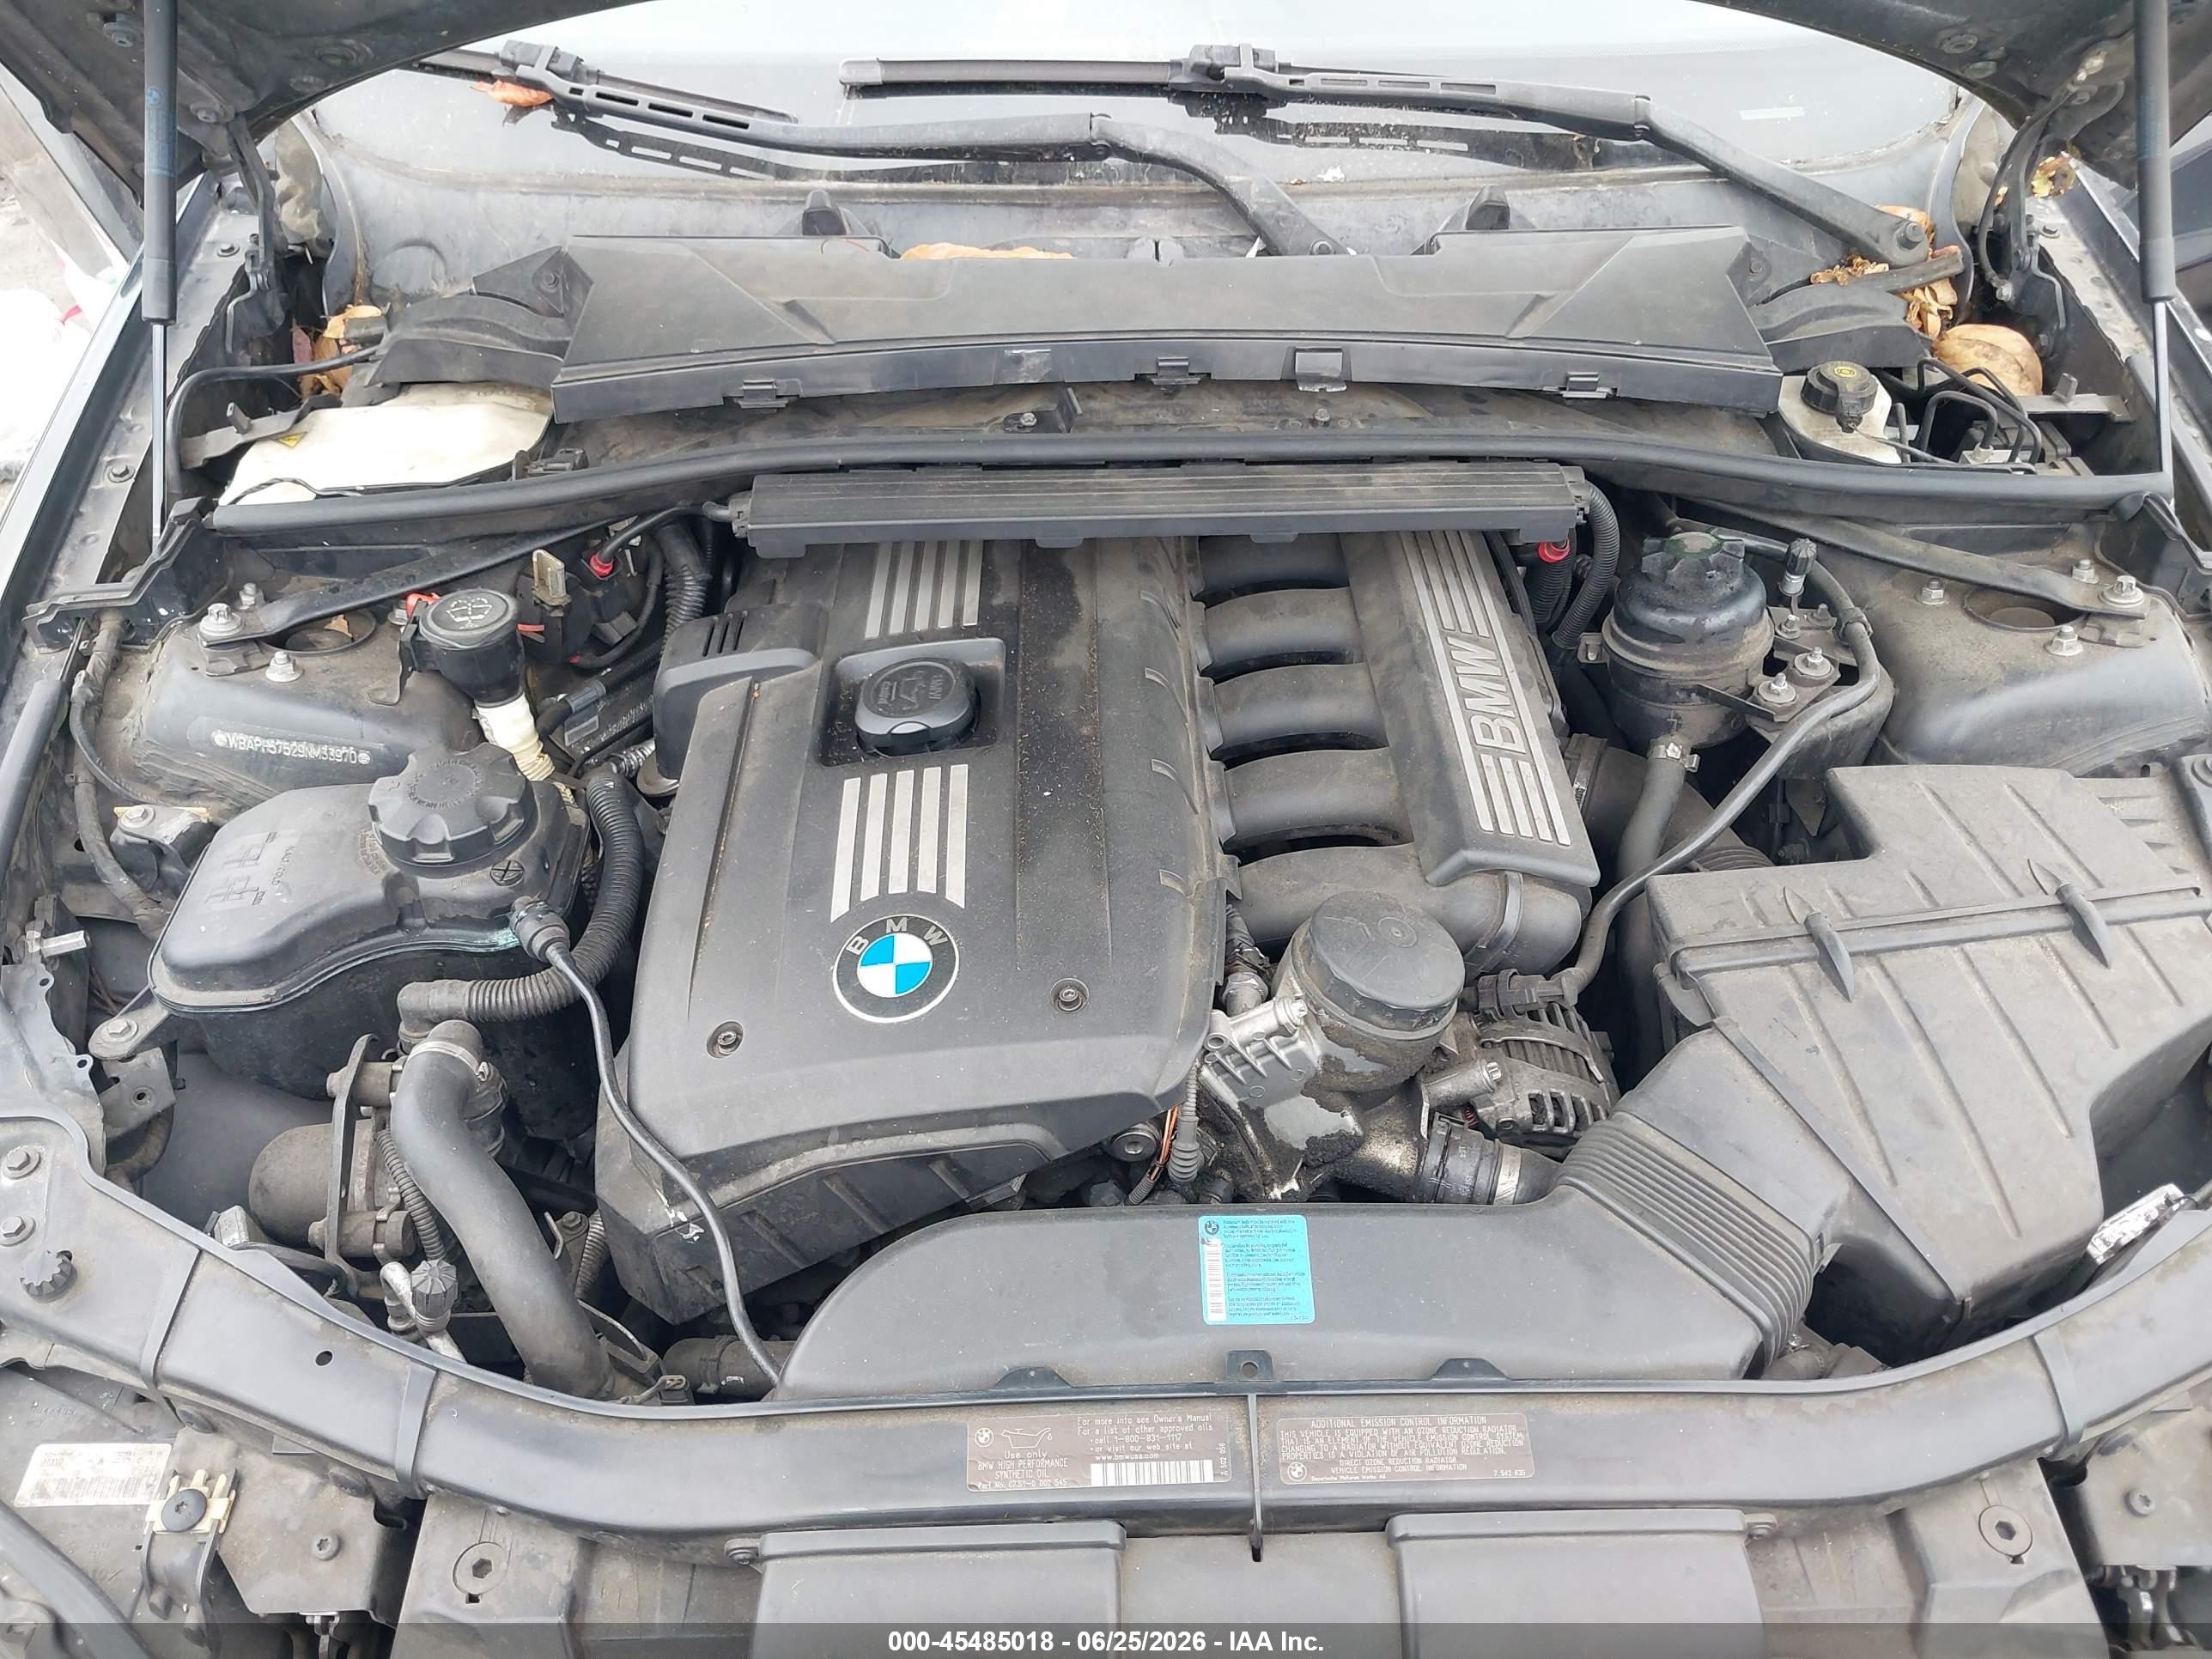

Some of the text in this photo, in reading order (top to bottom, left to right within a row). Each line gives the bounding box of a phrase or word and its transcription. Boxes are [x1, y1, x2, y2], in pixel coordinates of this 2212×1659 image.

[1447, 636, 1526, 754] BMW
[846, 917, 948, 955] BMW
[1079, 1417, 1090, 1425] For
[1187, 1413, 1212, 1422] Manual
[1311, 1415, 1486, 1429] ADDITIONAL EMISSION CONTROL INFORMATION
[1079, 1427, 1090, 1436] For
[1104, 1425, 1117, 1434] list
[1122, 1425, 1130, 1434] of
[1135, 1425, 1154, 1434] other
[1160, 1423, 1194, 1434] approved
[1198, 1422, 1212, 1431] oils
[1300, 1429, 1329, 1437] VEHICLE
[1346, 1428, 1378, 1437] EQUIPPED
[1382, 1427, 1400, 1436] WITH
[1443, 1425, 1479, 1434] REDUCTION
[1115, 1433, 1182, 1443] 1-800-831-1117
[1328, 1436, 1358, 1444] ELEMENT
[1185, 1441, 1192, 1449] at
[1281, 1444, 1316, 1453] CHANGING
[1341, 1443, 1376, 1451] RADIATOR
[1415, 1441, 1457, 1449] EQUIVALENT
[1005, 1449, 1048, 1460] Use only
[1282, 1451, 1324, 1460] PROPERTIES
[1349, 1449, 1388, 1458] VIOLATION
[1420, 1448, 1458, 1456] POLLUTION
[978, 1458, 1068, 1471] BMW HIGH PERFORMANCE
[1362, 1465, 1391, 1474] EMISSION
[1425, 1463, 1467, 1472] INFORMATION
[995, 1468, 1049, 1480] SYNTHETIC OIL
